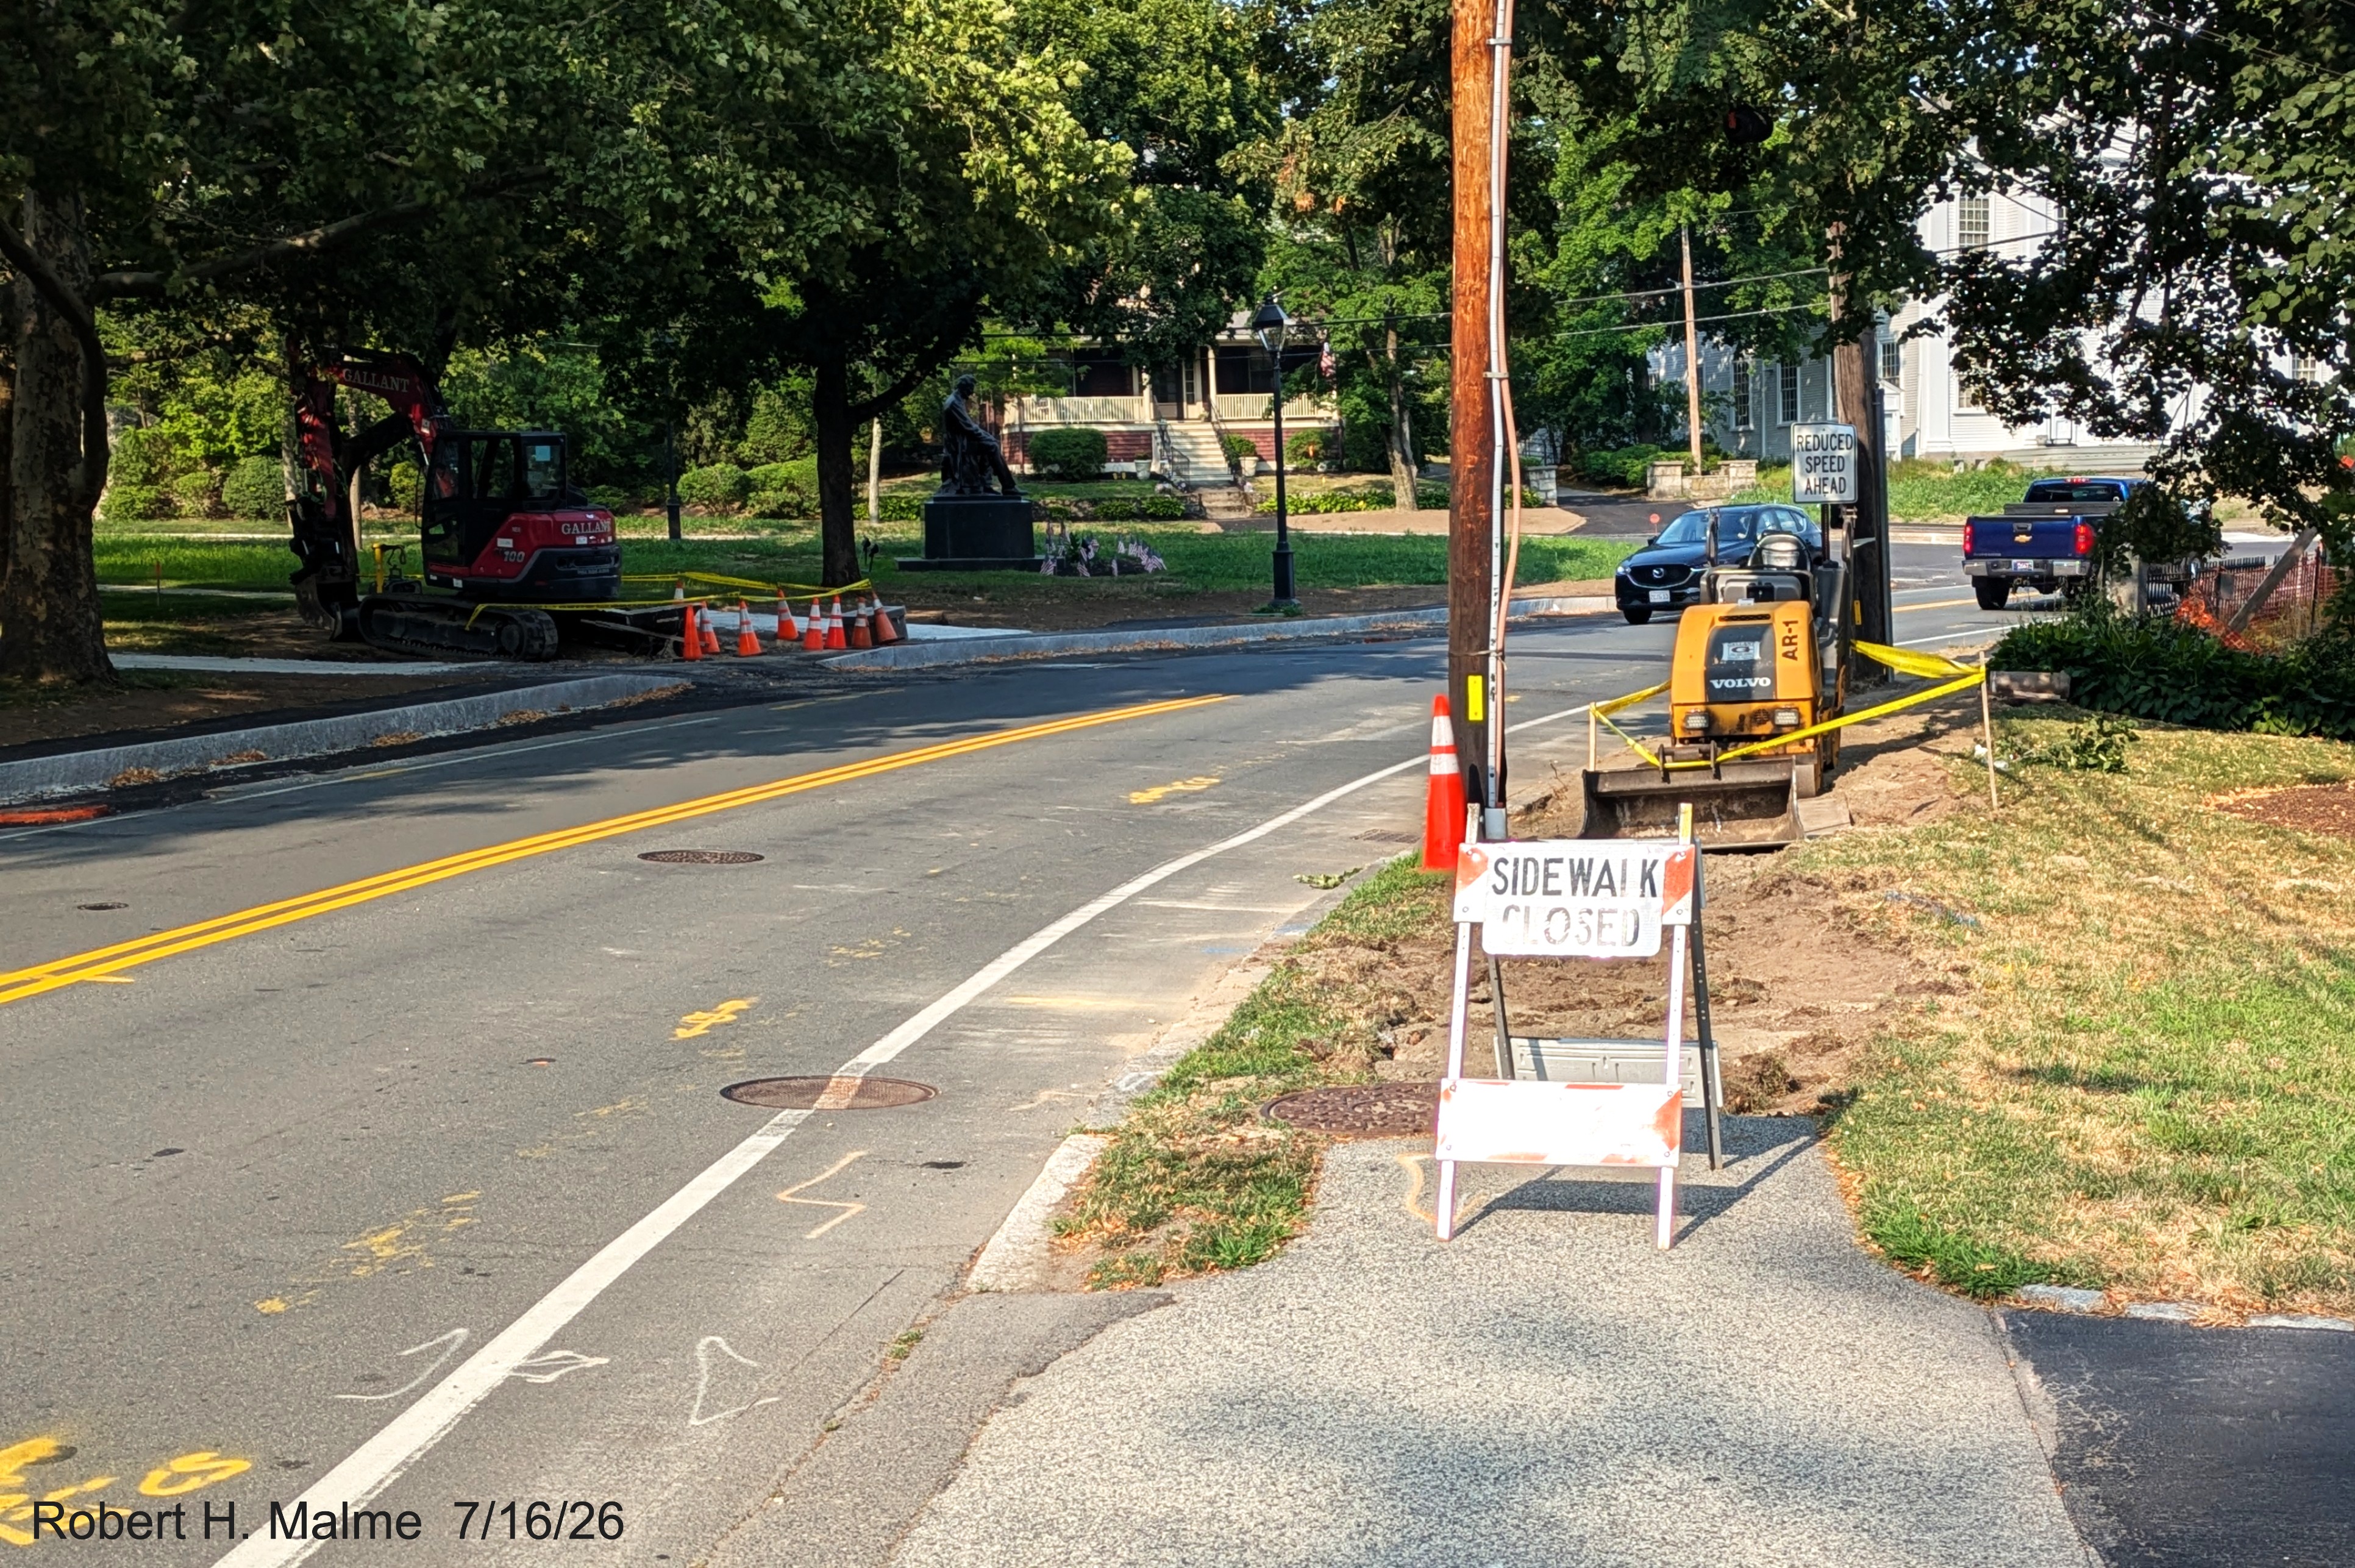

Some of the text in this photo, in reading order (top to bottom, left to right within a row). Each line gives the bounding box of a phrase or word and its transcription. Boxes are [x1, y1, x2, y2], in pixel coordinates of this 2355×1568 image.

[343, 368, 410, 393] GALLANT
[1797, 433, 1853, 452] REDUCED
[1805, 455, 1845, 473] SPEED
[1805, 477, 1847, 495] AHEAD
[1782, 620, 1798, 661] AR-1
[1710, 677, 1771, 689] VOLVO
[1491, 857, 1659, 898] SIDEWALK
